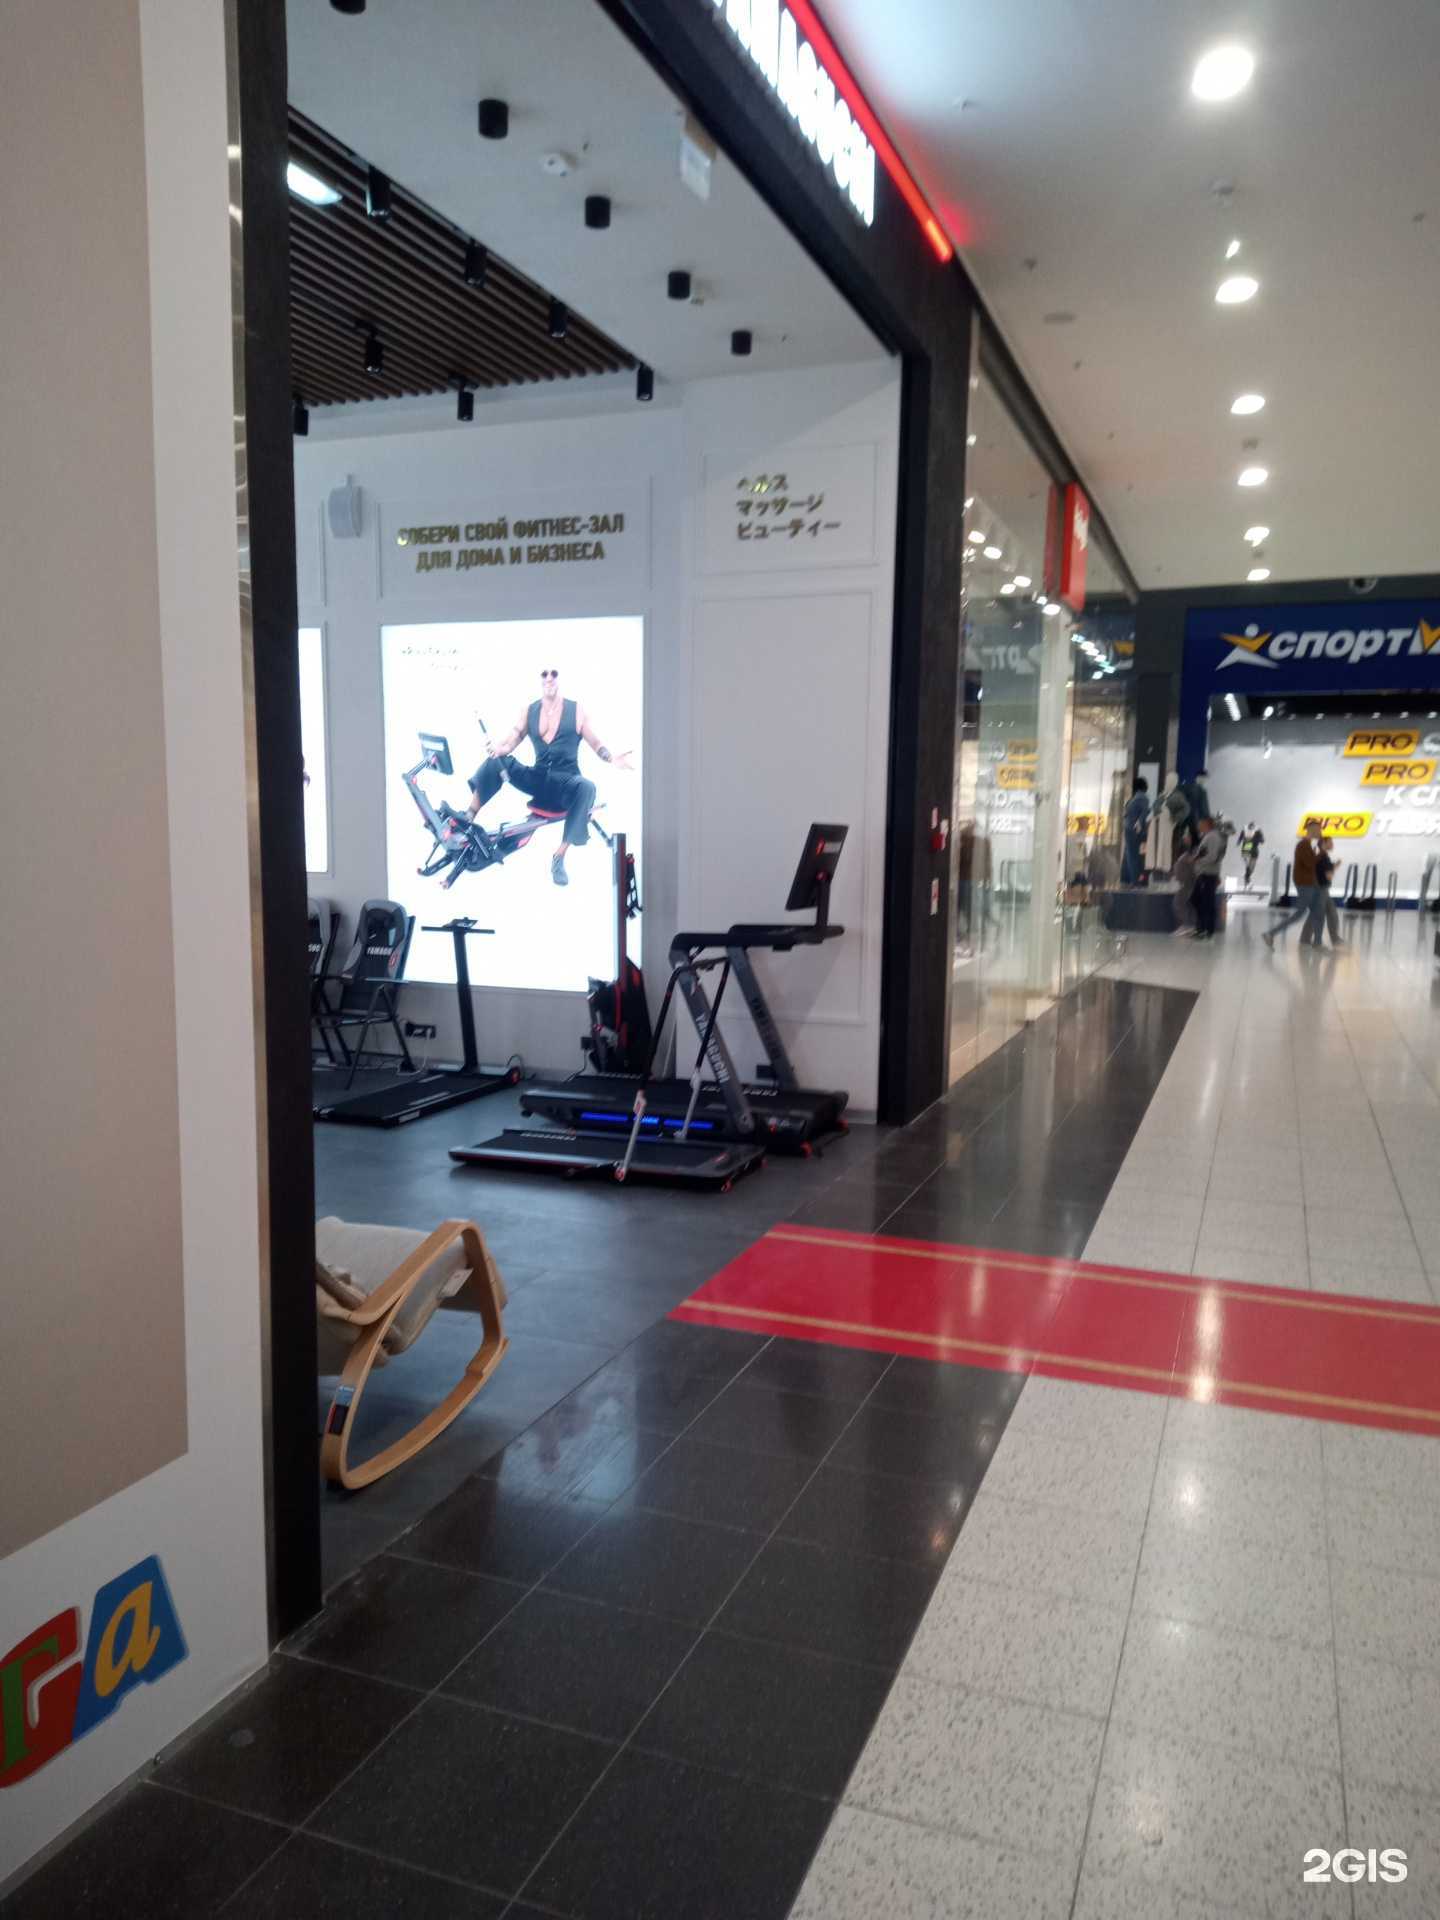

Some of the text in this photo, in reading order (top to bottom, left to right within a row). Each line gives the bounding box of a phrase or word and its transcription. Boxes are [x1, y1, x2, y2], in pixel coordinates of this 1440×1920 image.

[464, 517, 508, 541] СВОЙ
[513, 513, 624, 539] ФИТНЕС-ЗАЛ
[416, 541, 605, 573] ДЛЯ ДОМА И БИЗНЕСА
[1349, 733, 1413, 750] PRO
[1365, 762, 1429, 780] PRO
